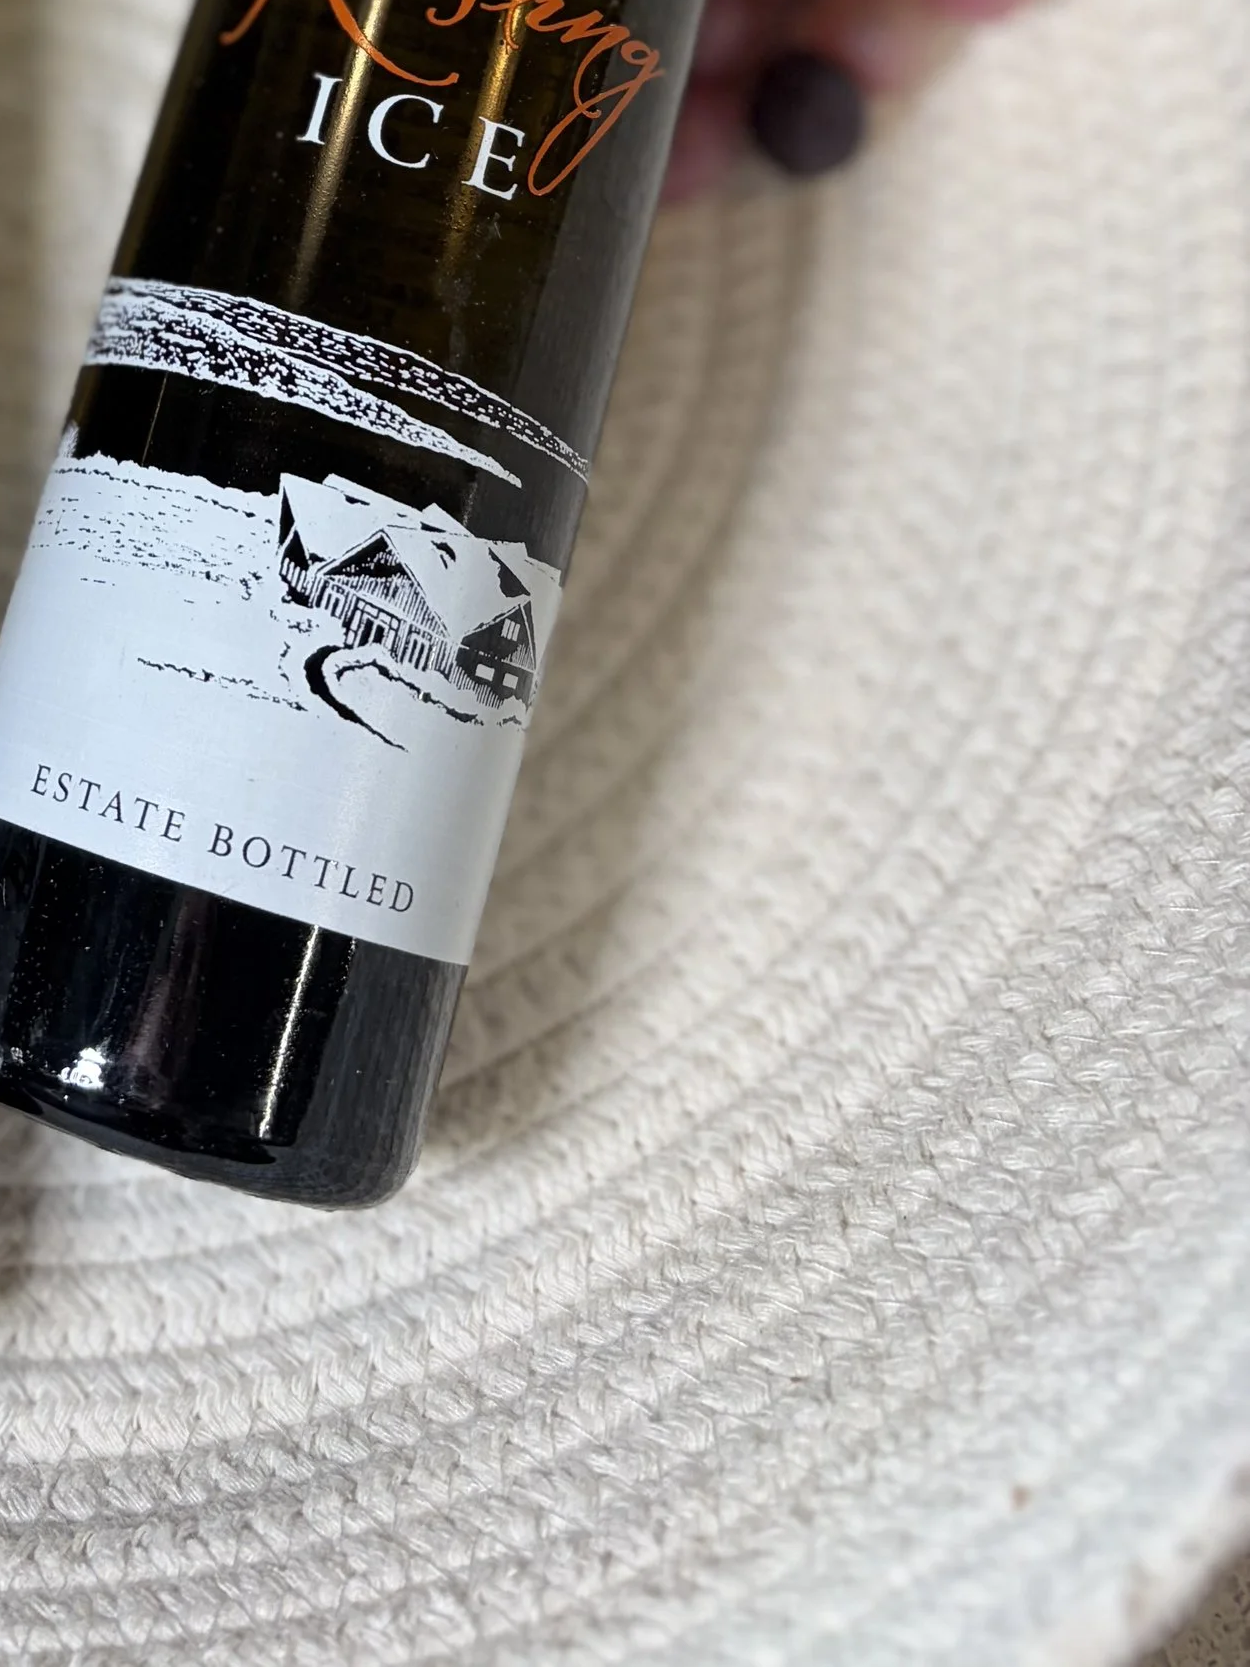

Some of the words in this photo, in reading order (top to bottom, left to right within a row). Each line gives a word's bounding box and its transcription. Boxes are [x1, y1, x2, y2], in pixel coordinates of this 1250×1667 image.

[296, 72, 525, 200] ICE
[30, 764, 185, 842] ESTATE
[207, 823, 415, 913] BOTTLED
